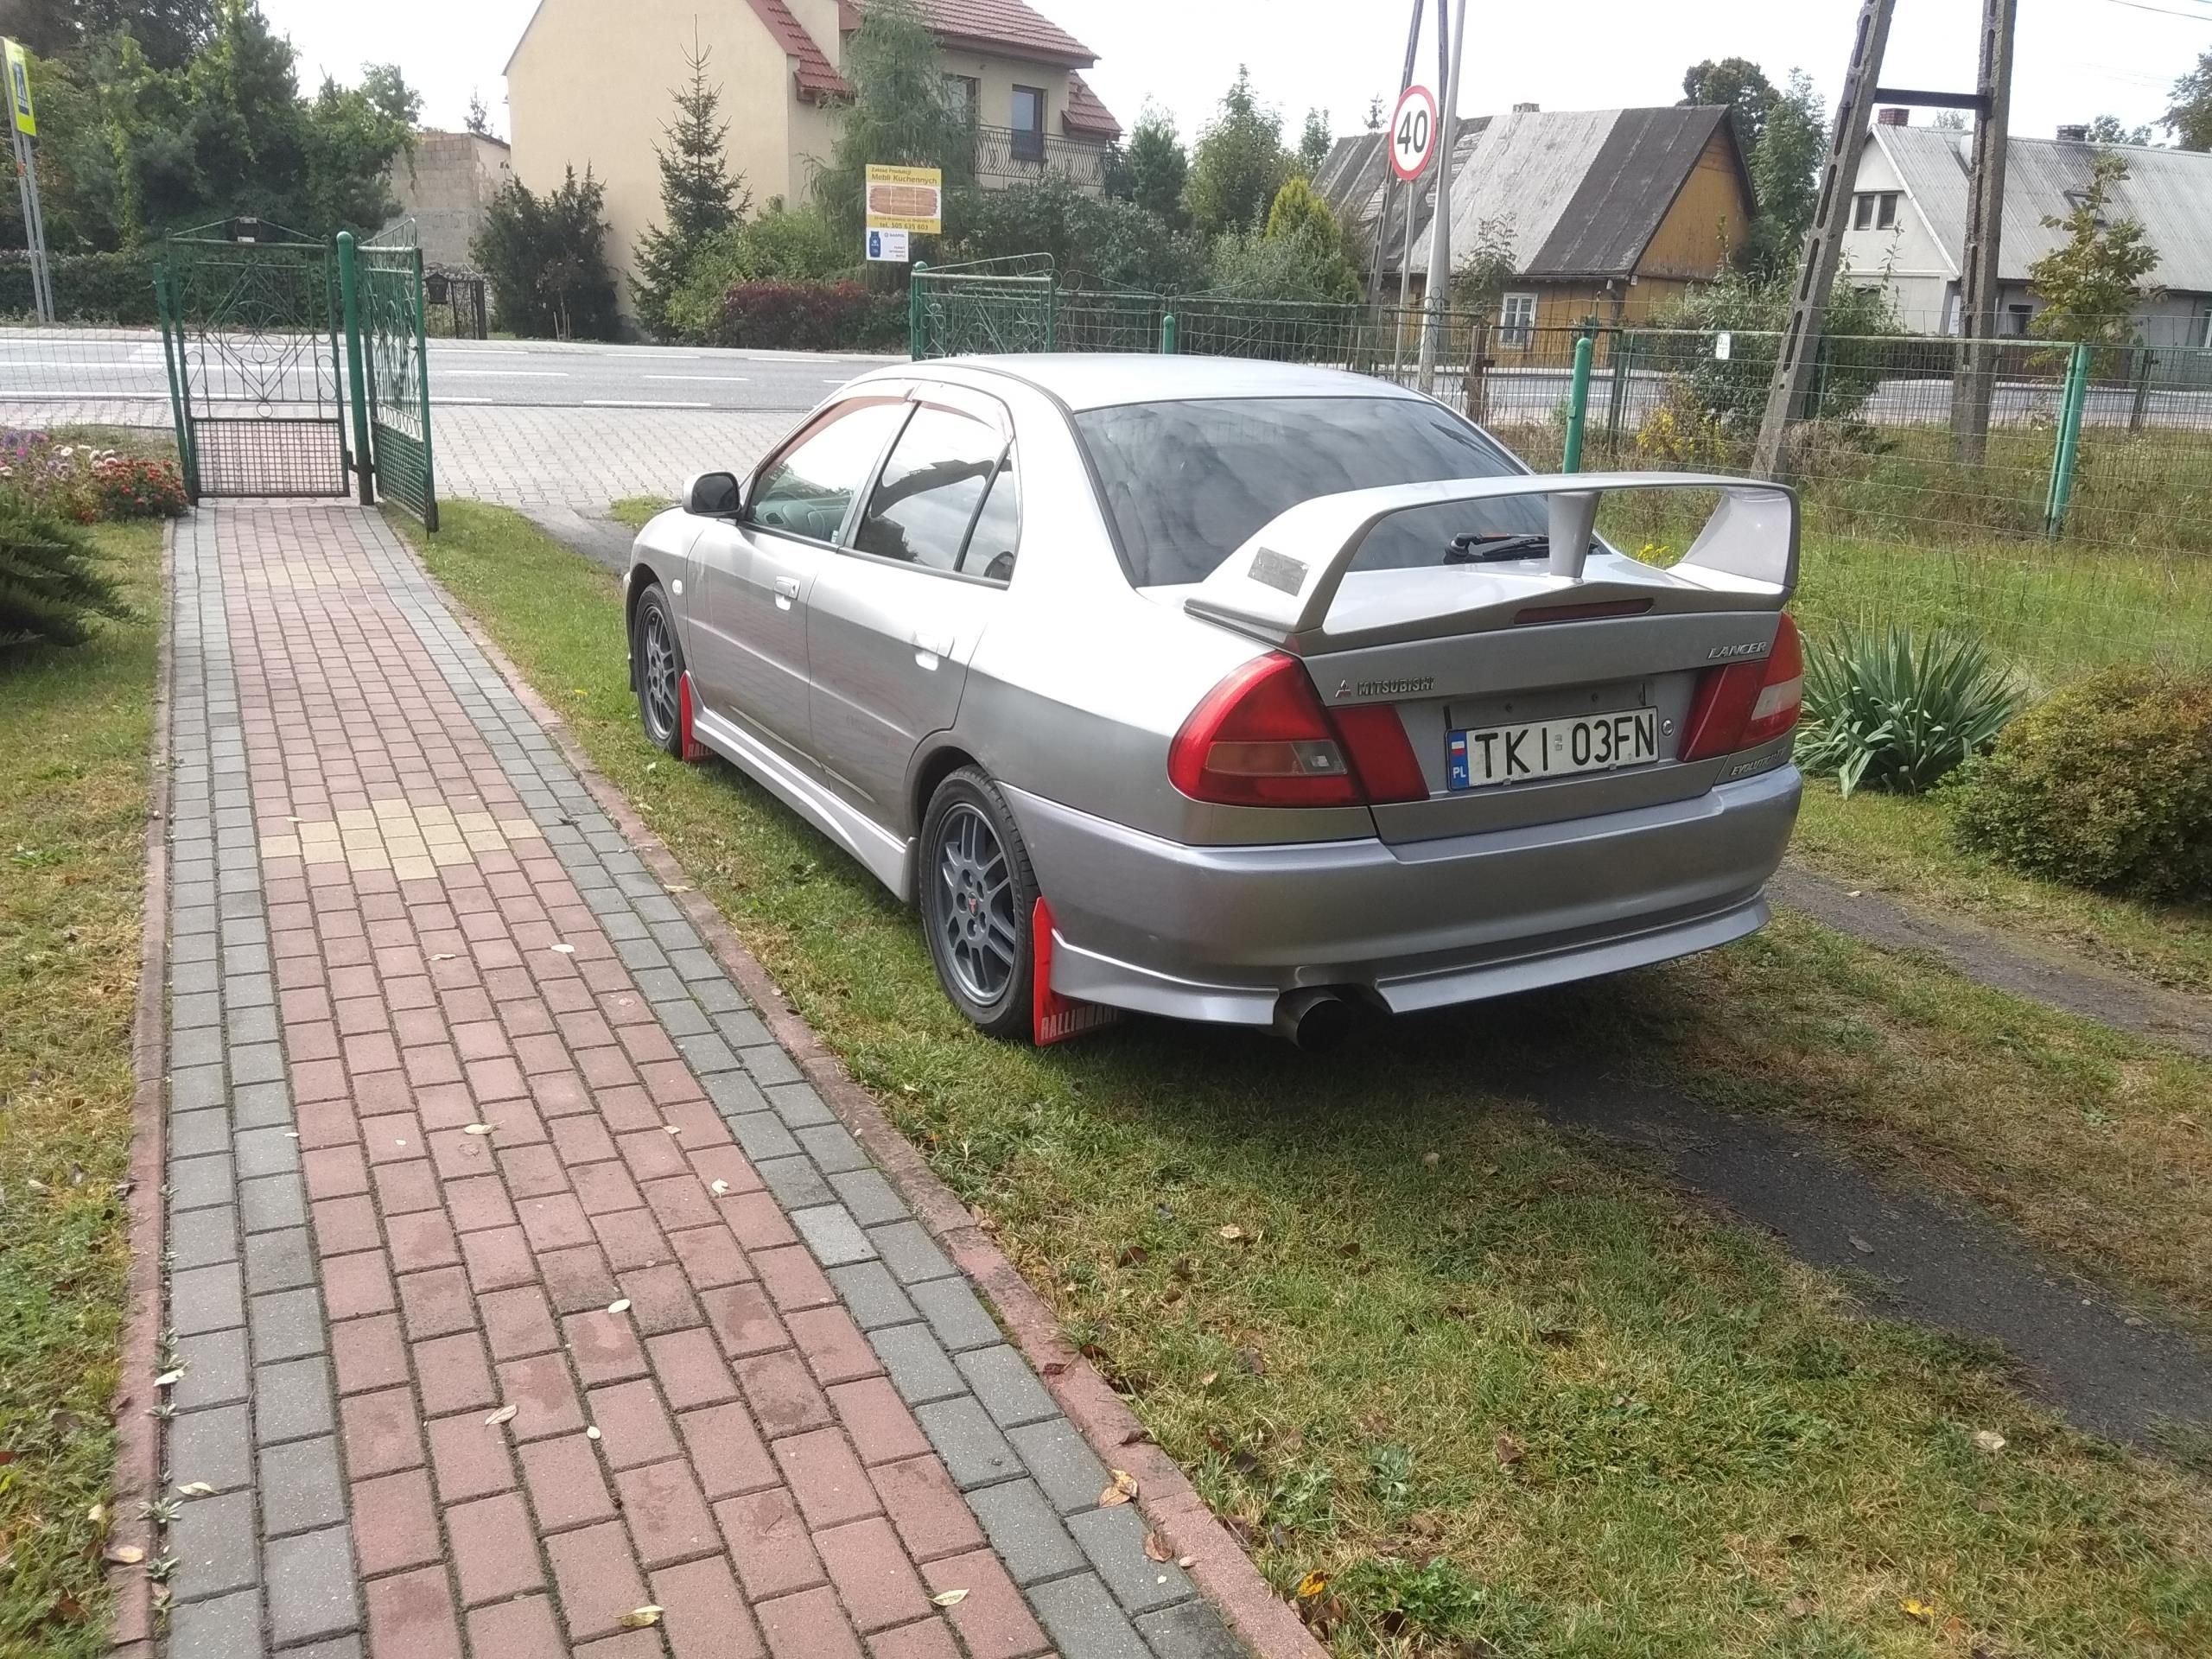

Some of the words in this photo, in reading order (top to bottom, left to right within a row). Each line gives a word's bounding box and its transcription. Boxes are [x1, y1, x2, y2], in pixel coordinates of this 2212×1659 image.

[1396, 109, 1428, 155] 40
[893, 175, 938, 185] Kuchennych
[1707, 641, 1767, 659] LANCER
[1357, 677, 1434, 696] MITSUBISHI
[1474, 727, 1548, 779] TKI
[1571, 713, 1655, 766] 03FN
[1452, 766, 1466, 778] PL
